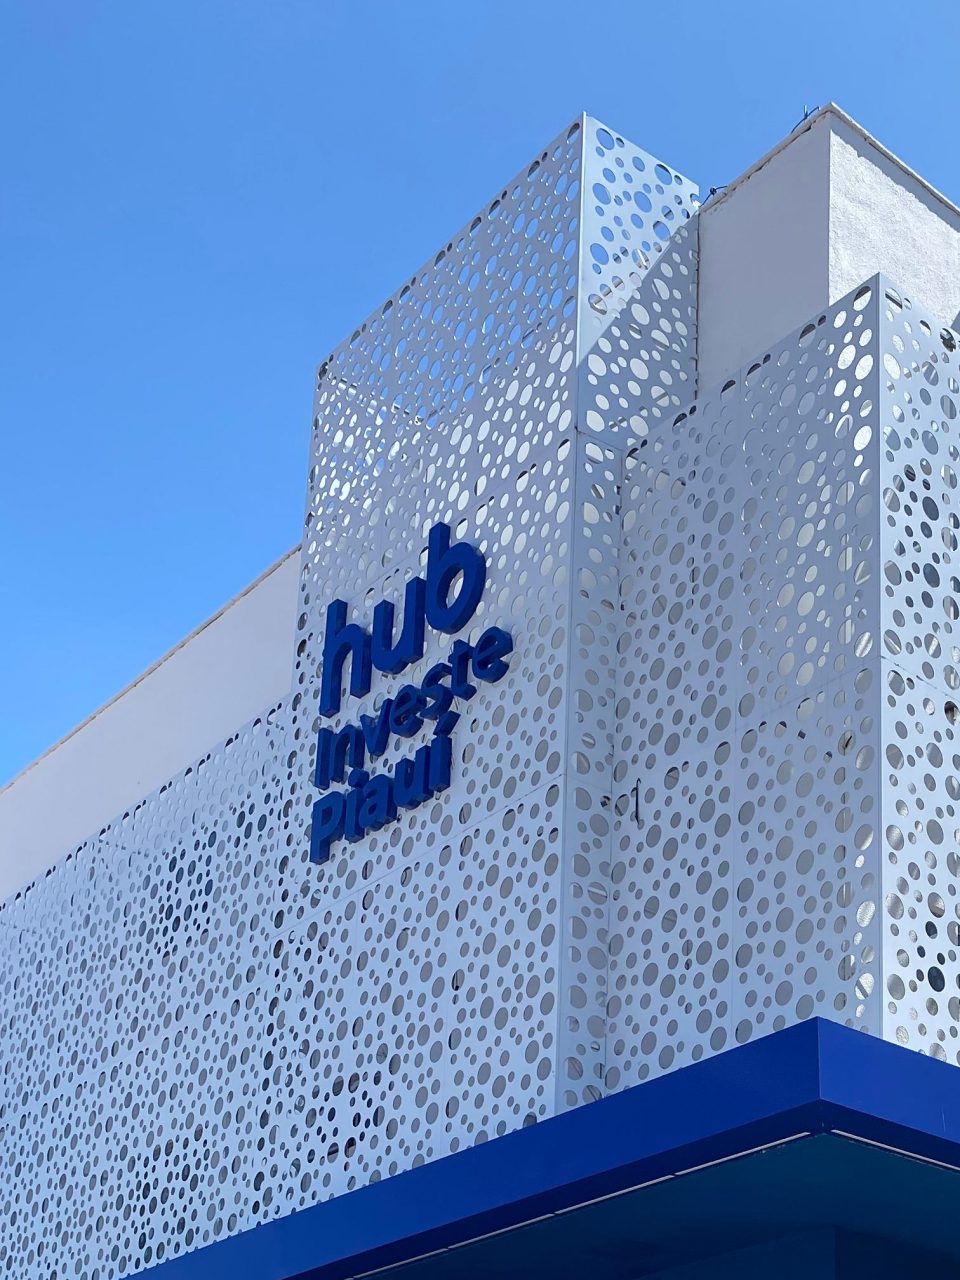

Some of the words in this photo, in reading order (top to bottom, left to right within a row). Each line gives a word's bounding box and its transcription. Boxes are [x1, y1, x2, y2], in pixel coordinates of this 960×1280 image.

[319, 521, 487, 718] hub
[310, 711, 461, 865] Piauí
[314, 625, 513, 790] Investe
